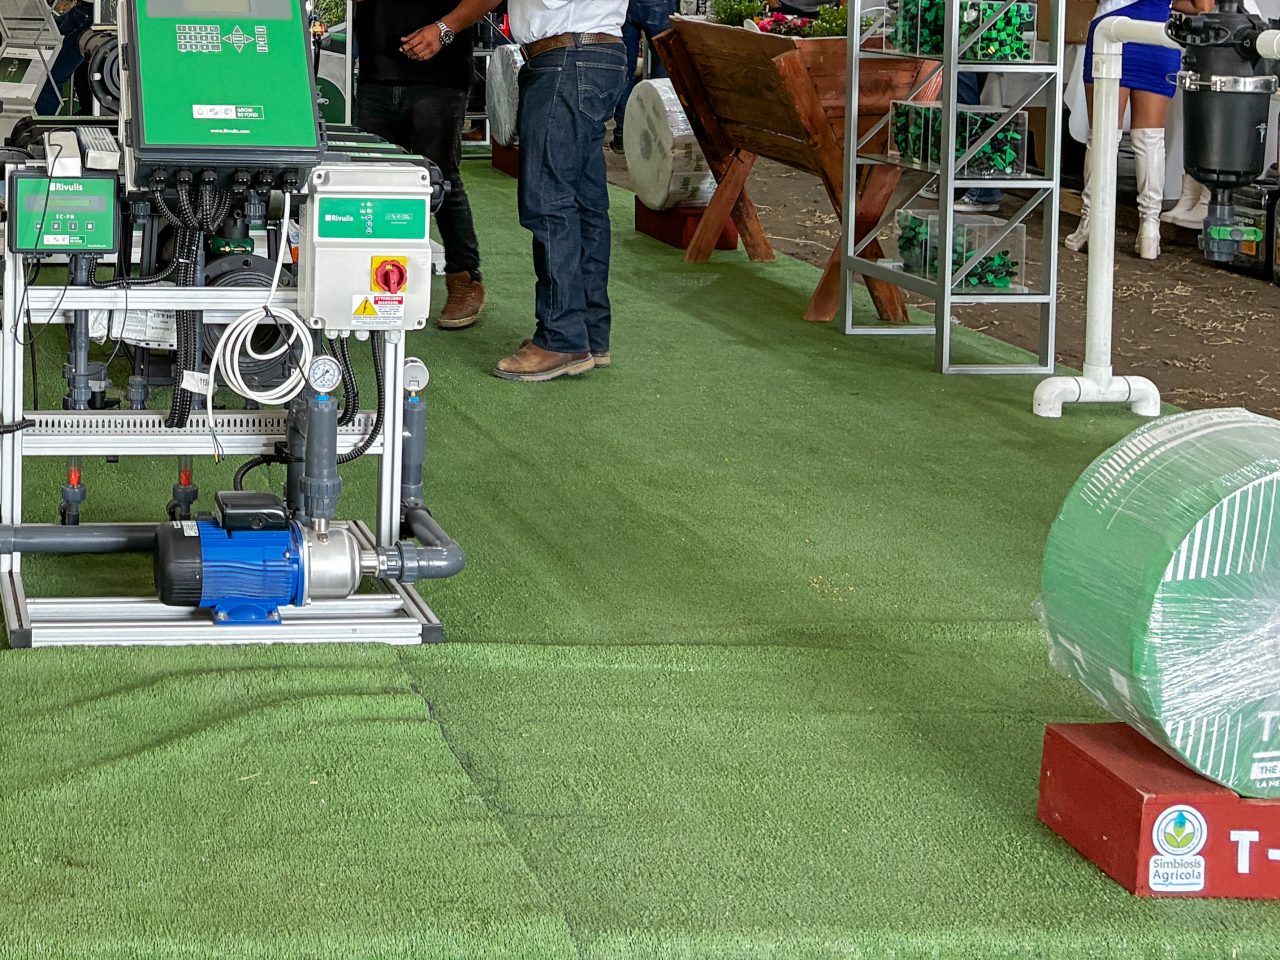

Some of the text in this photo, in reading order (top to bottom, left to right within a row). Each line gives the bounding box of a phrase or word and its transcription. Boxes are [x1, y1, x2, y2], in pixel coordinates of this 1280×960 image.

[56, 183, 83, 191] Rivulis
[331, 214, 354, 222] Rivulis
[1260, 765, 1278, 775] THE
[1153, 858, 1201, 869] Simbiosis
[1153, 869, 1201, 882] Agrícola
